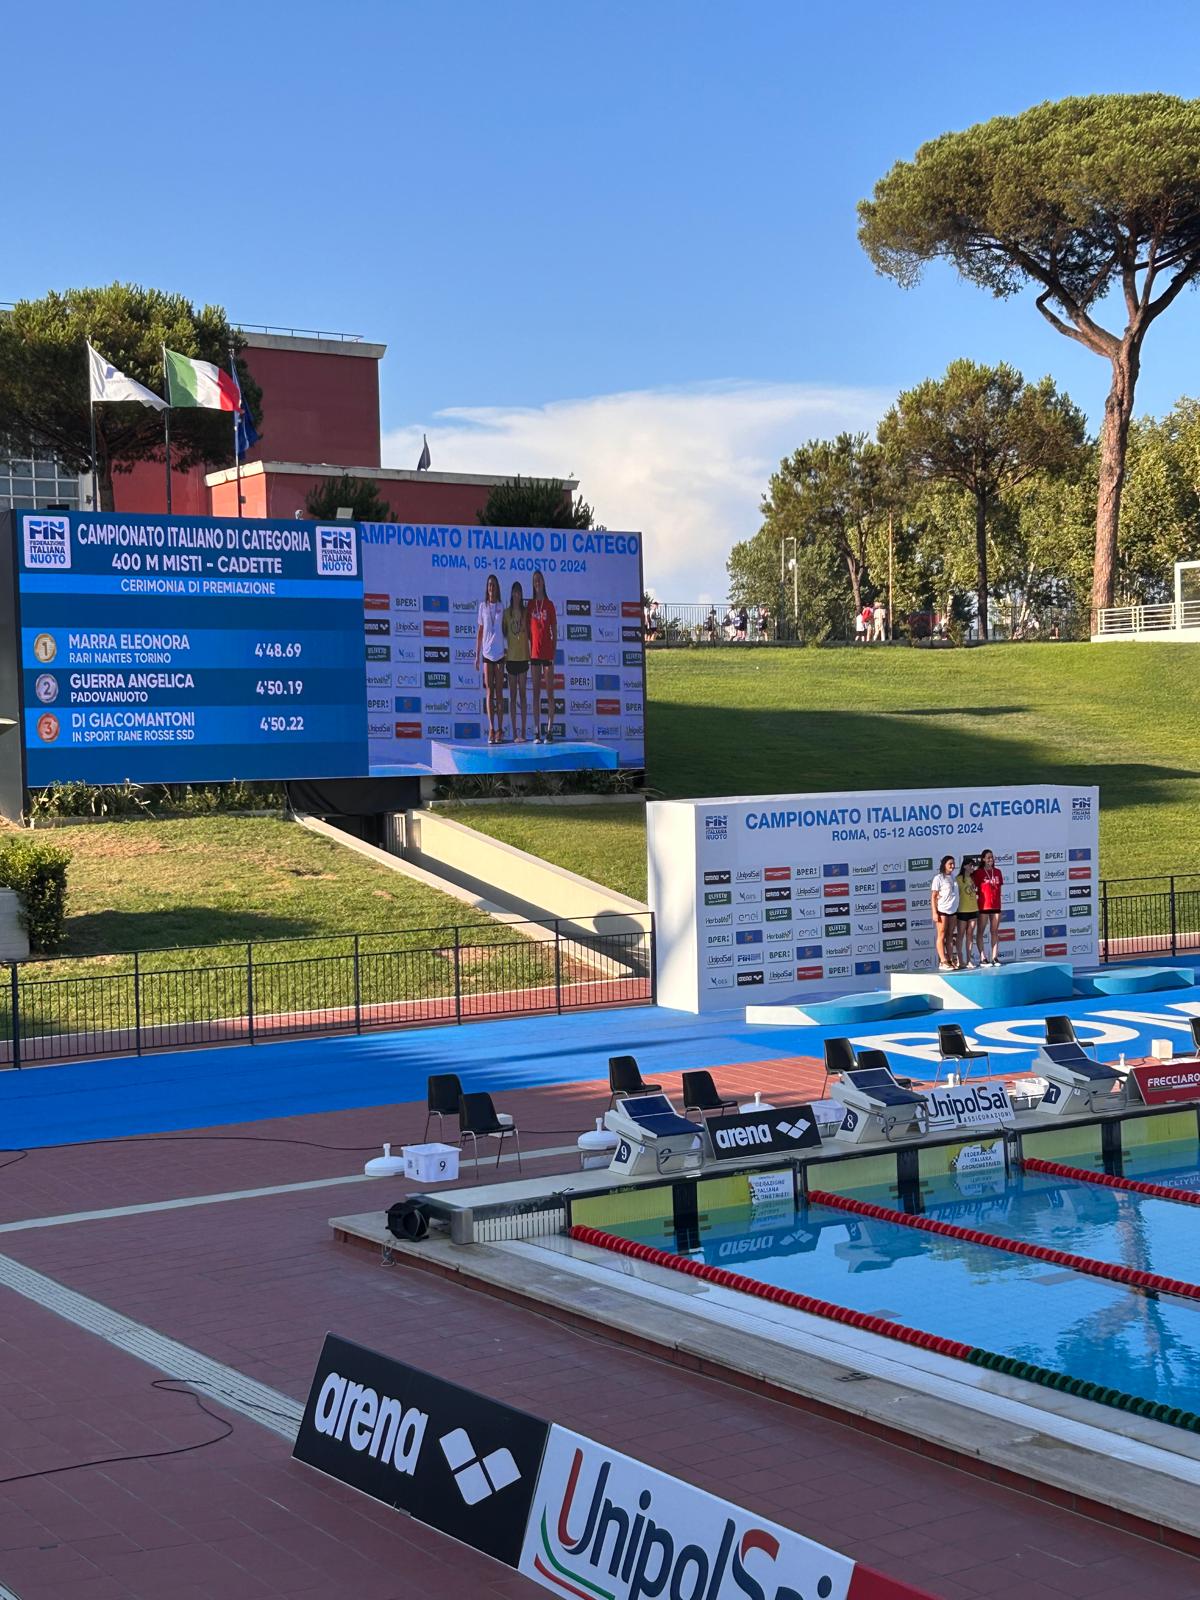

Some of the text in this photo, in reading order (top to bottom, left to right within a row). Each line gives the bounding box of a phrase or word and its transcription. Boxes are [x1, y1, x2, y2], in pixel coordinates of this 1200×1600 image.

[29, 521, 65, 540] FIN
[77, 523, 311, 552] CAMPIONATO ITALIANO DI CATEGORIA
[321, 531, 352, 549] FIN
[360, 524, 639, 555] AMPIONATO ITALIANO DI CATEGO
[30, 546, 65, 554] ITALIANA
[31, 554, 66, 564] NUOTO
[112, 553, 141, 571] 400
[146, 554, 159, 571] M
[163, 555, 202, 572] MISTI
[217, 556, 283, 574] CADETTE
[322, 562, 353, 571] NUOTO
[432, 553, 586, 573] ROMA, 05-12 AGOSTO 2024
[121, 578, 276, 594] CERIMONIA DI PREMIAZIONE
[69, 634, 190, 650] MARRA ELEONORA
[69, 652, 171, 664] RARI NANTES TORINO
[254, 643, 302, 658] 4'48.69
[70, 673, 195, 688] GUERRA ANGELICA
[256, 680, 303, 695] 4'50.19
[43, 681, 51, 696] 2
[71, 691, 148, 703] PADOVANUOTO
[72, 712, 195, 728] DI GIACOMANTONI
[260, 716, 304, 731] 4'50.22
[44, 721, 52, 735] 3
[72, 729, 195, 742] IN SPORT RANE ROSSE SSD
[745, 798, 1062, 830] CAMPIONATO ITALIANO DI CATEGORIA
[832, 822, 984, 841] ROMA, 05-12 AGOSTO 2024
[1147, 1073, 1200, 1087] FRECCIARO
[928, 1086, 1009, 1123] UnipolSai
[847, 1114, 854, 1129] 8
[963, 1111, 1012, 1123] ASSICURAZIONI
[715, 1123, 773, 1149] arena
[621, 1145, 628, 1160] 9
[438, 1160, 447, 1172] 9
[314, 1372, 429, 1476] arena
[558, 1447, 832, 1600] UnipolS
